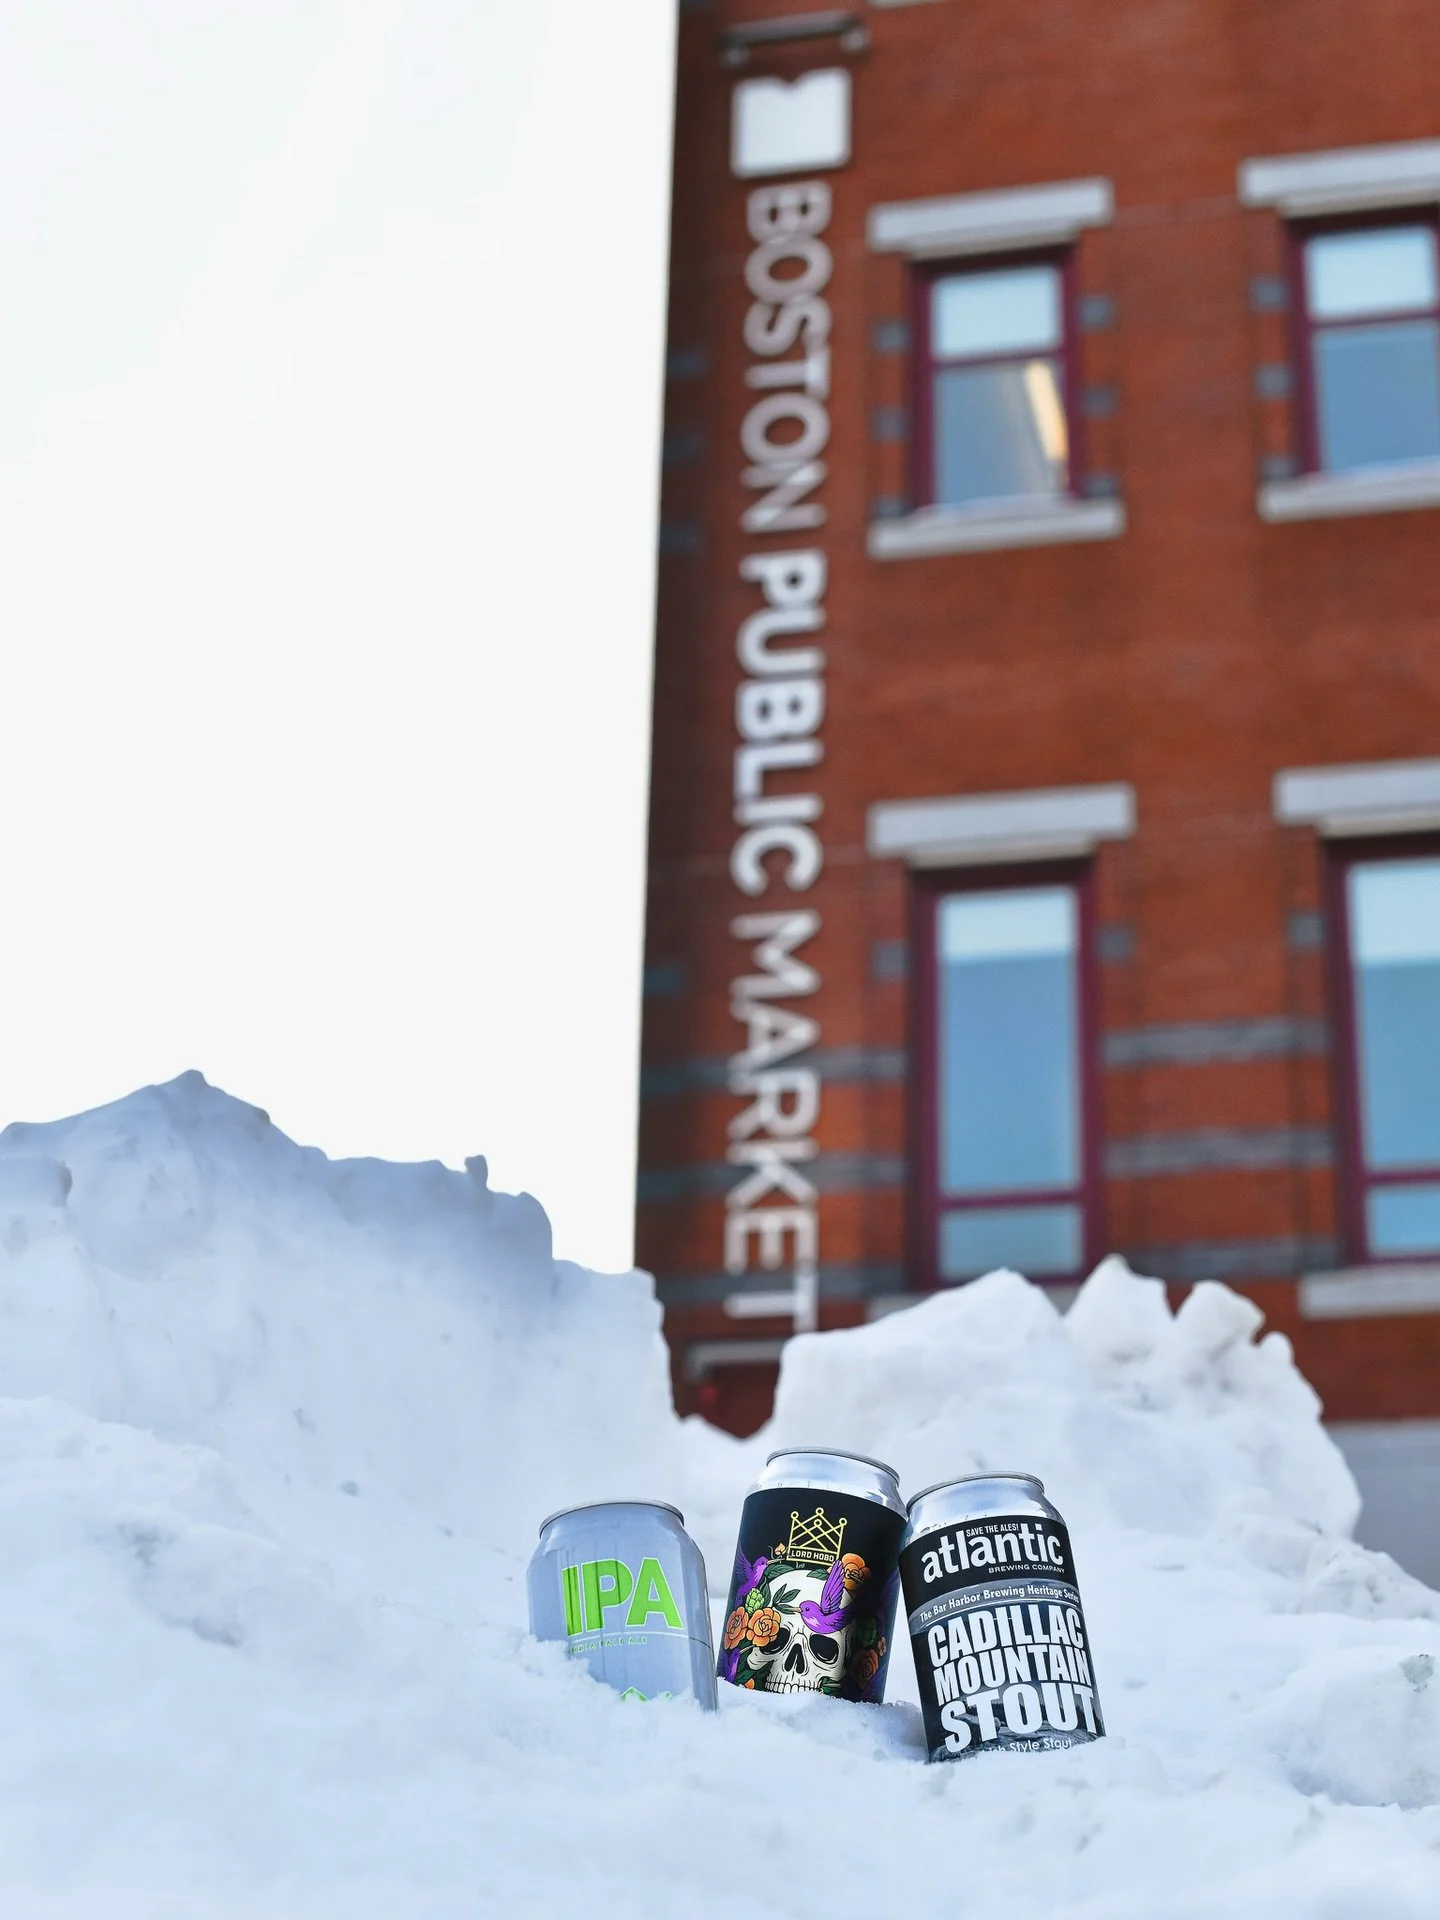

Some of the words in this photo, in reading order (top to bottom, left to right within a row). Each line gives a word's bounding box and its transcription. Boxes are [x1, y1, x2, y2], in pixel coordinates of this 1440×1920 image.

[740, 179, 833, 534] BOSTON
[729, 548, 828, 895] PUBLIC
[723, 908, 822, 1333] MARKET
[791, 1550, 812, 1559] LORD
[813, 1553, 835, 1563] HOBO
[921, 1523, 1064, 1584] atlantic
[966, 1527, 984, 1537] SAVE
[984, 1525, 999, 1534] THE
[1000, 1523, 1020, 1532] ALES!
[561, 1556, 685, 1637] IPA
[988, 1564, 1031, 1574] BREWING
[1032, 1564, 1065, 1574] COMPANY
[919, 1607, 933, 1623] The
[933, 1603, 947, 1616] Bar
[948, 1593, 981, 1609] Harbor
[983, 1586, 1025, 1600] Brewing
[1027, 1585, 1063, 1599] Heritage
[927, 1604, 1084, 1668] CADILLAC
[933, 1644, 1092, 1707] MOUNTAIN
[940, 1682, 1097, 1753] STOUT
[1009, 1740, 1040, 1752] Style
[1043, 1738, 1072, 1750] Stout
